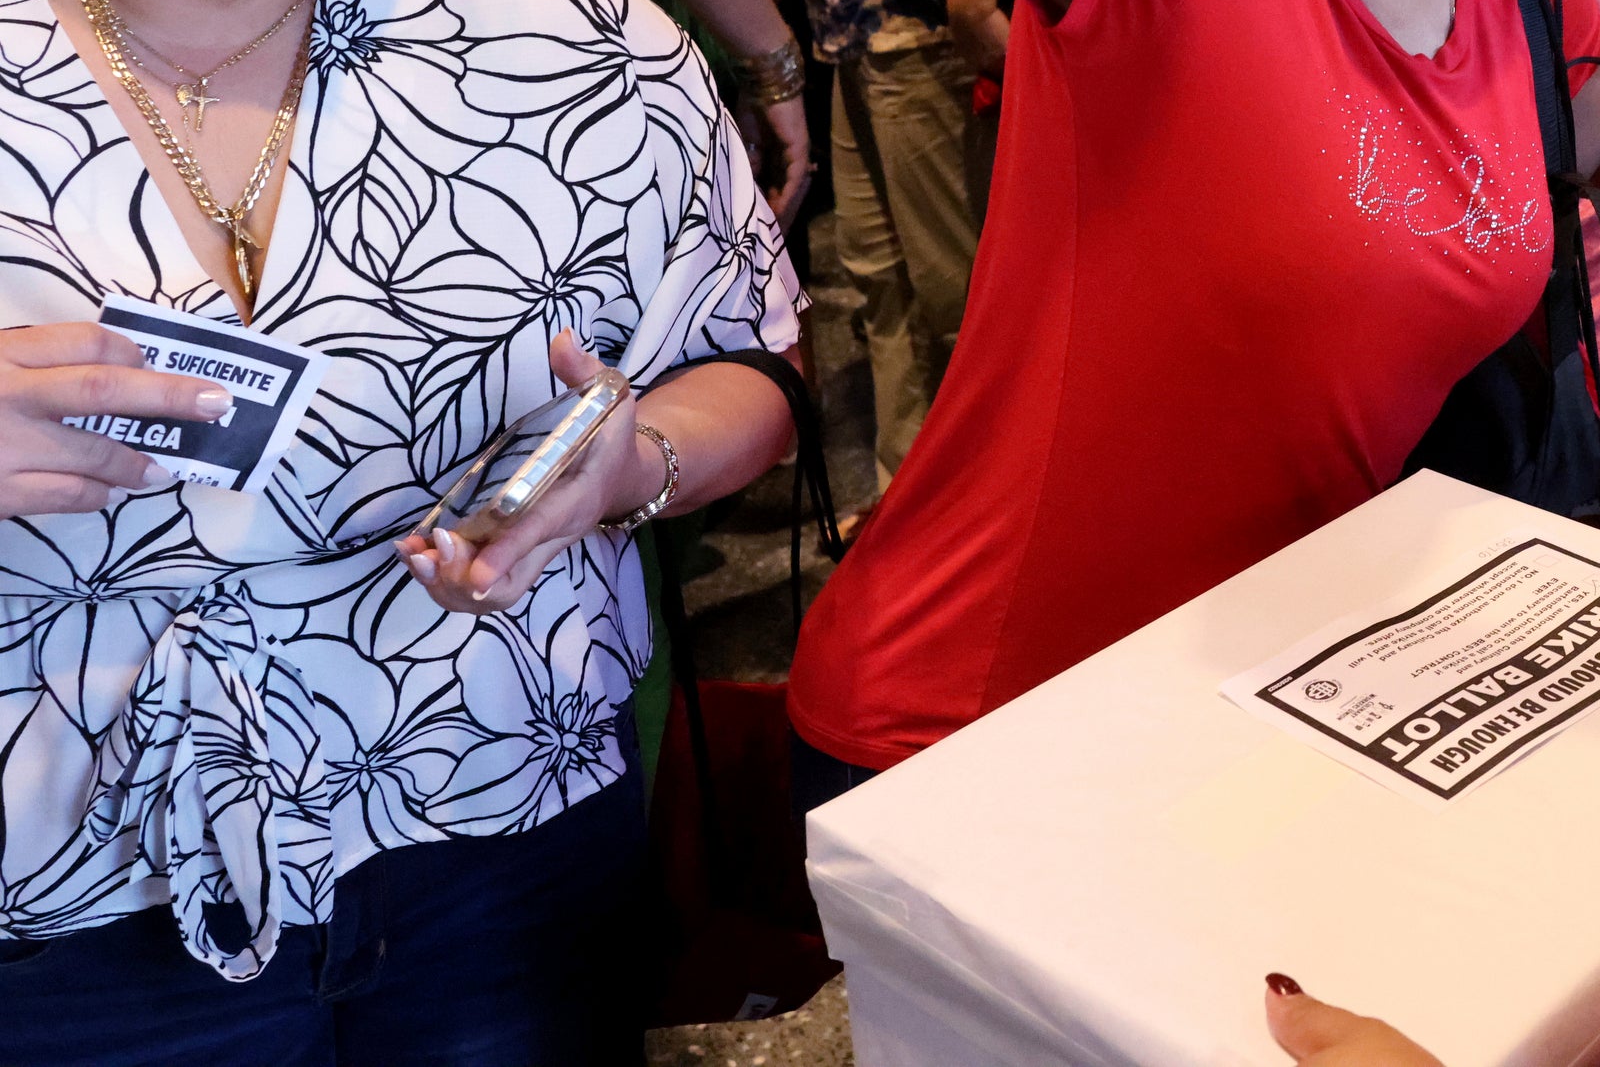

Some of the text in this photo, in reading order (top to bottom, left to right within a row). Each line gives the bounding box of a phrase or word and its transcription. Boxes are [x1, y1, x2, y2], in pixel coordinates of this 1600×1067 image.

[165, 351, 275, 392] SUFICIENTE
[1380, 664, 1533, 762] BALLOT
[1506, 697, 1547, 722] BE
[1429, 713, 1521, 773] ENOUGH
